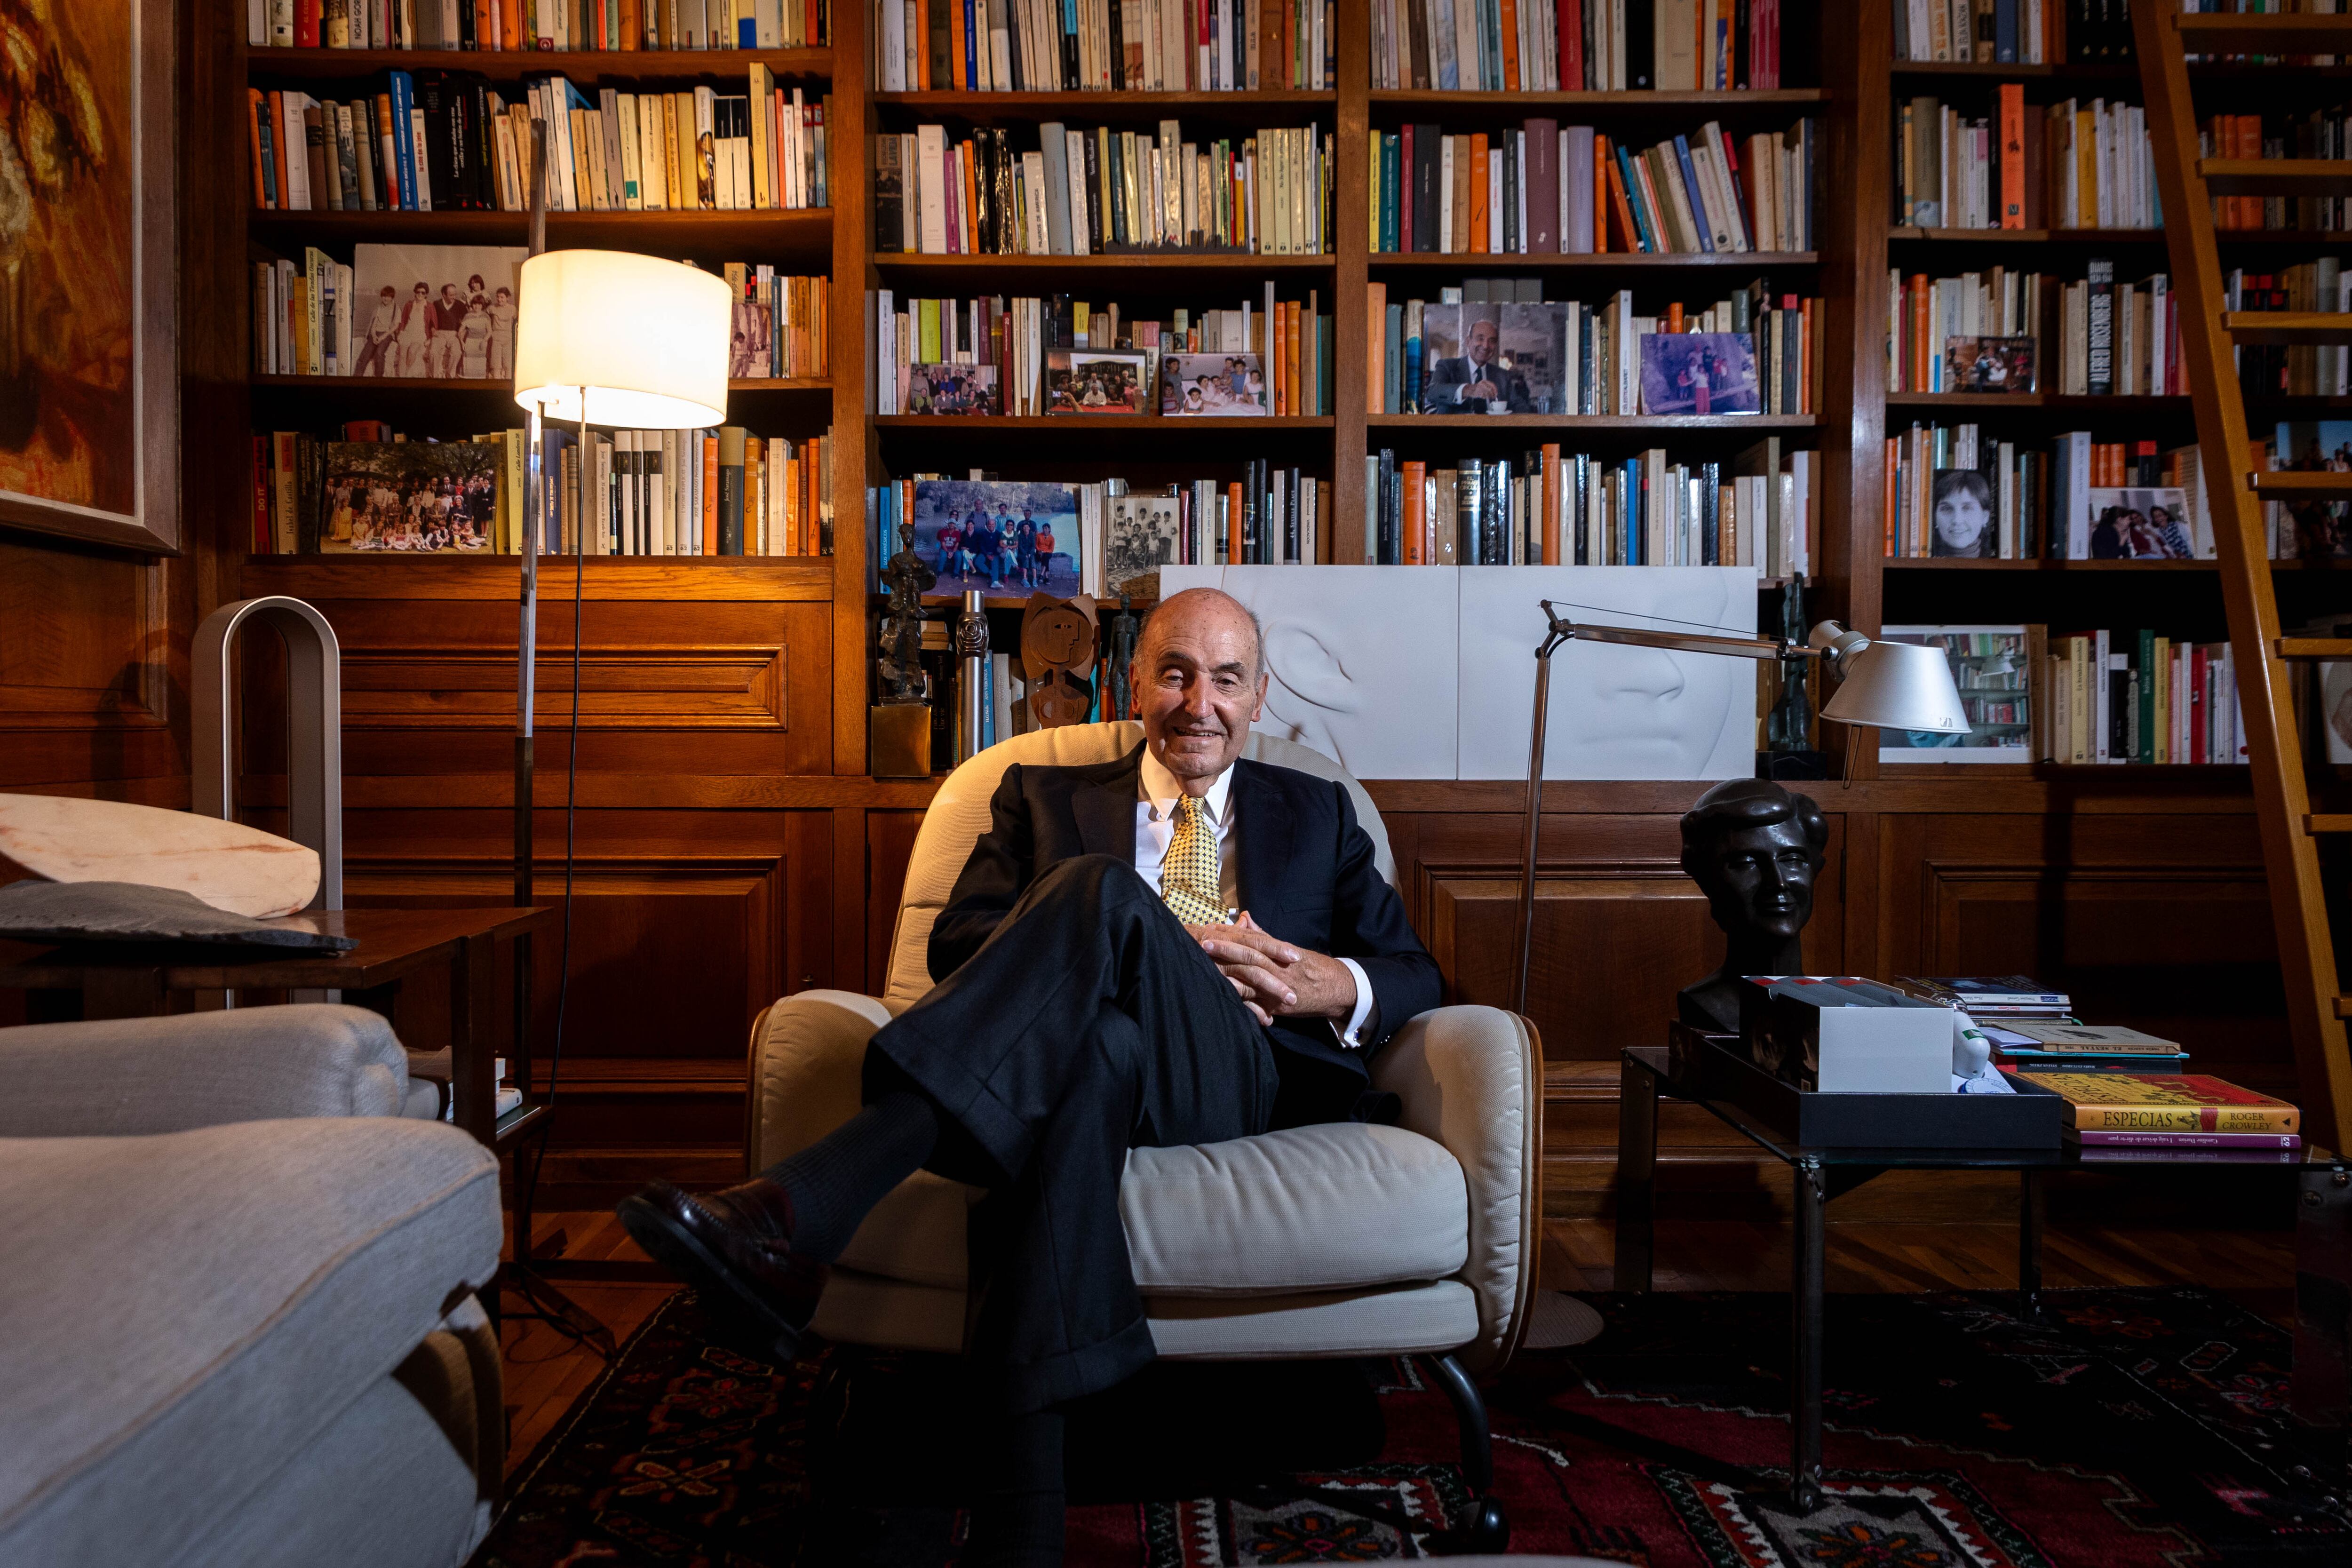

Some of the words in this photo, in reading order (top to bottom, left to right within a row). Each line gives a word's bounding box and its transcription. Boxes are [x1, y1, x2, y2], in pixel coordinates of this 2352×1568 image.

[2090, 294, 2111, 348] ROSENBERG
[2090, 349, 2110, 383] ALFRED
[285, 481, 293, 504] Castilla
[258, 498, 265, 510] DO
[2103, 1111, 2172, 1127] ESPECIAS
[2282, 1137, 2290, 1146] 62
